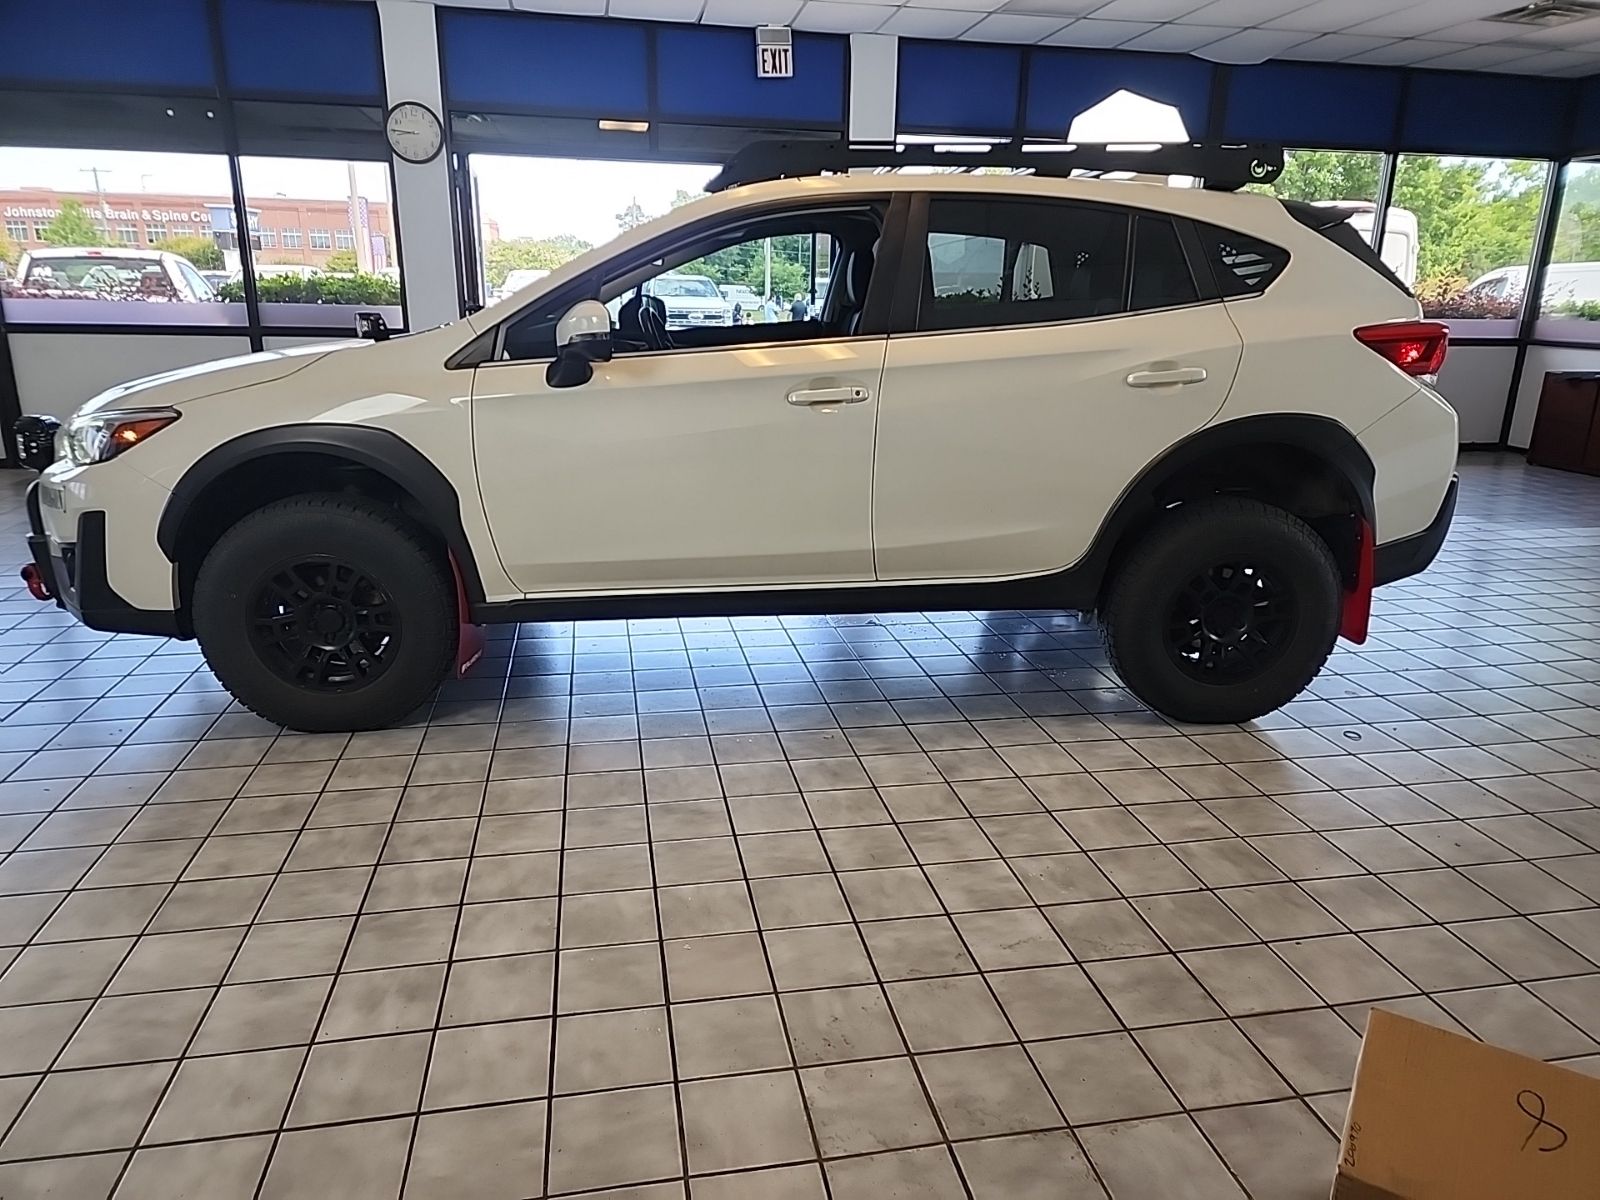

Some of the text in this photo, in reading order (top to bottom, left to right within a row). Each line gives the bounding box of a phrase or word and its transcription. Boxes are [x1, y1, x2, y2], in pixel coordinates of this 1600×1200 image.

[761, 48, 790, 74] EXIT
[104, 208, 139, 220] Brain
[142, 209, 151, 220] &
[152, 209, 189, 223] Spine
